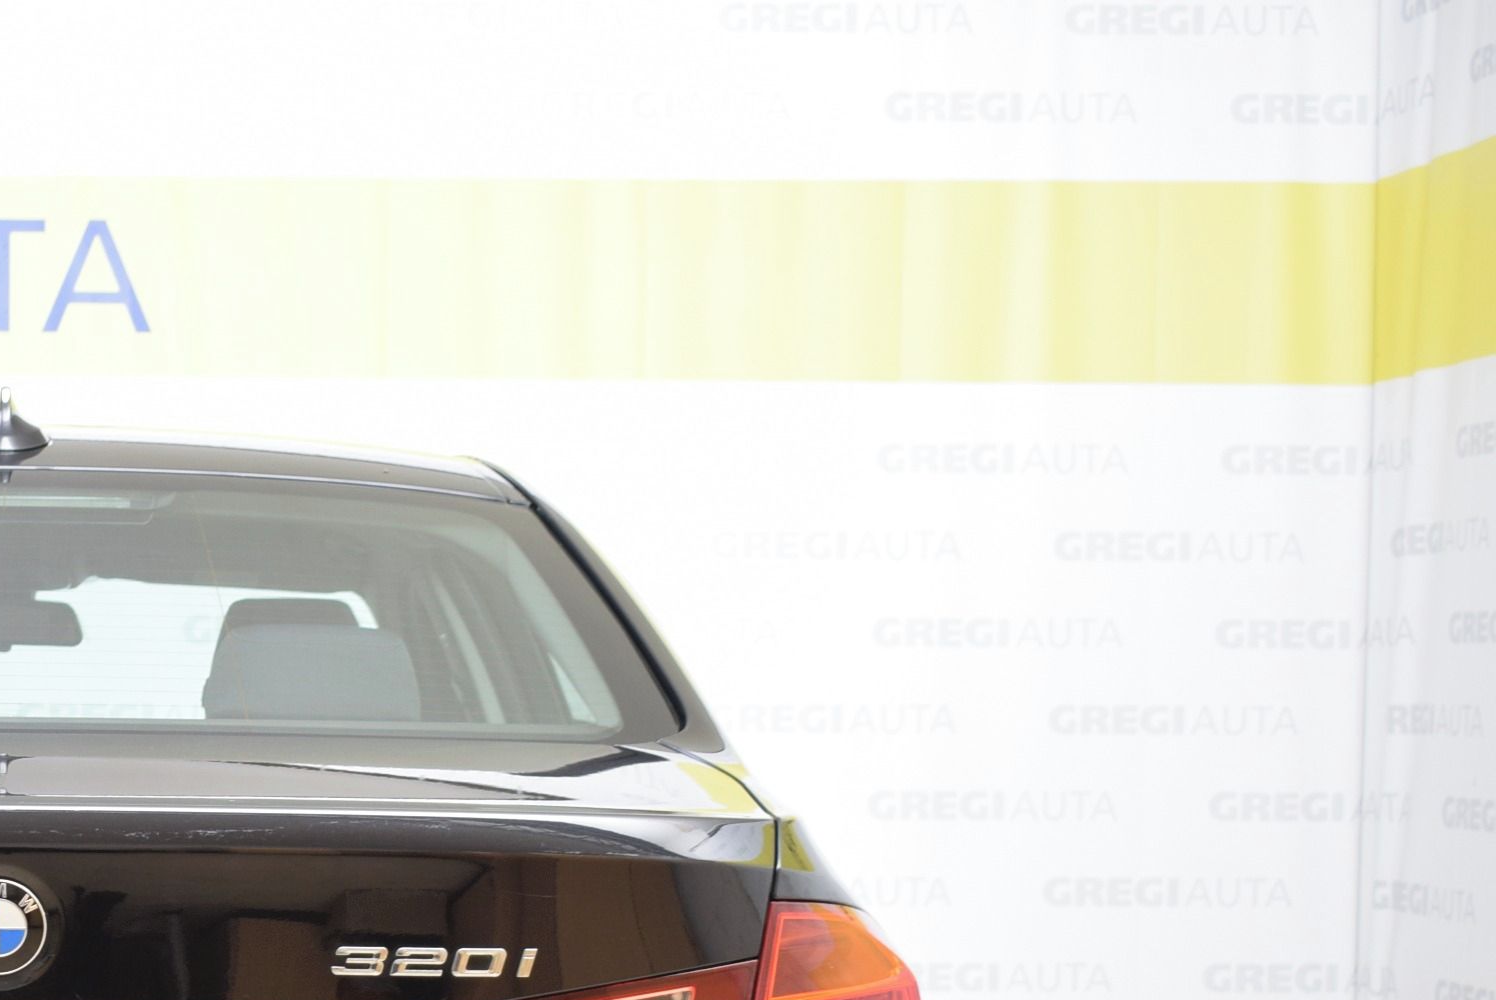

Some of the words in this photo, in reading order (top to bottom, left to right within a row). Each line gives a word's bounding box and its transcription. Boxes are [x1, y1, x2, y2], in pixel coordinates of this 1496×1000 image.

[884, 91, 1138, 124] GREGIAUTA
[876, 444, 1129, 476] GREGIAUTA
[1053, 530, 1305, 563] GREGIAUTA
[872, 617, 1124, 650] GREGIAUTA
[1047, 704, 1300, 737] GREGIAUTA
[868, 789, 1119, 823] GREGIAUTA
[1042, 877, 1292, 910] GREGIAUTA
